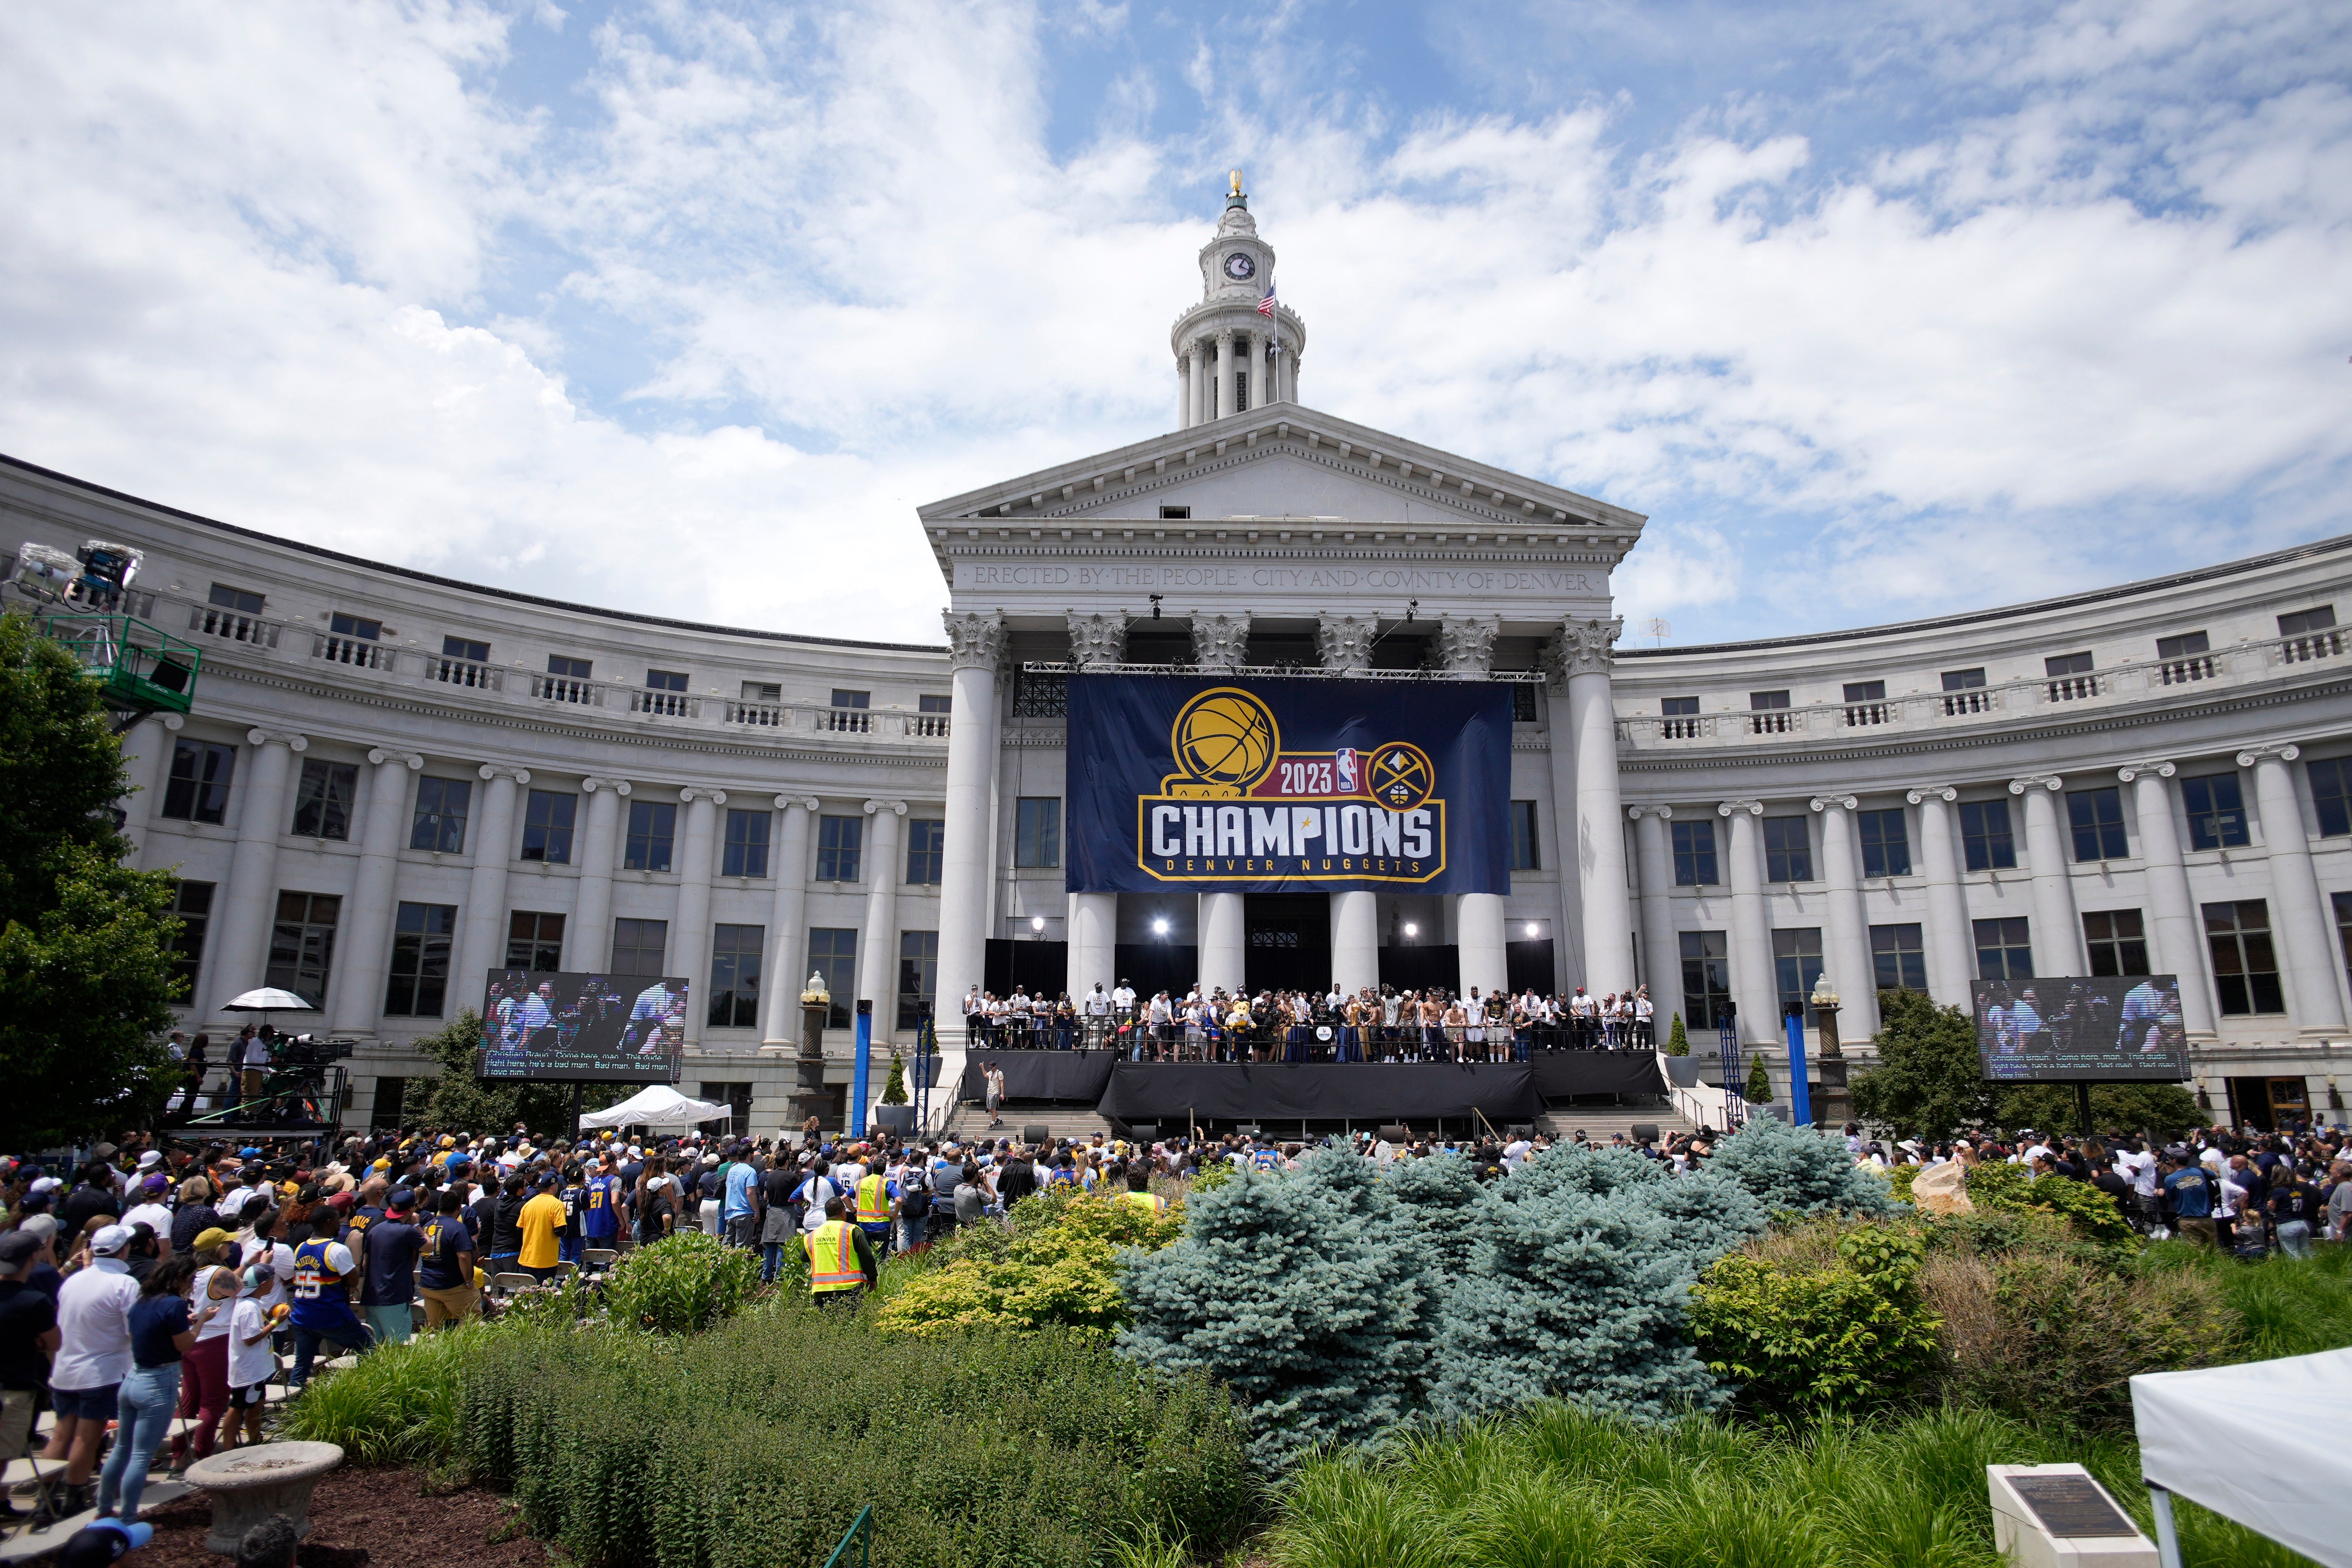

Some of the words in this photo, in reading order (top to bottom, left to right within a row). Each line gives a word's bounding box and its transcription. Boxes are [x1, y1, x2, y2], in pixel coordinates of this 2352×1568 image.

[975, 567, 1069, 584] ERECTED
[1079, 568, 1105, 584] BY
[1112, 568, 1154, 584] THE
[1163, 568, 1238, 585] PEOPLE
[1253, 569, 1302, 586] CITY
[1310, 570, 1357, 586] AND
[1367, 570, 1460, 588] COVNTY
[1467, 572, 1494, 589] OF
[1504, 573, 1593, 590] DENVER
[1281, 763, 1332, 794] 2023
[1152, 805, 1431, 858] CHAMPIONS
[1167, 859, 1273, 871] DENVER
[1302, 859, 1419, 872] NUGGETS
[591, 1182, 606, 1191] MURRAY
[590, 1191, 603, 1209] 27
[2292, 1199, 2303, 1212] 27
[294, 1270, 321, 1298] 55
